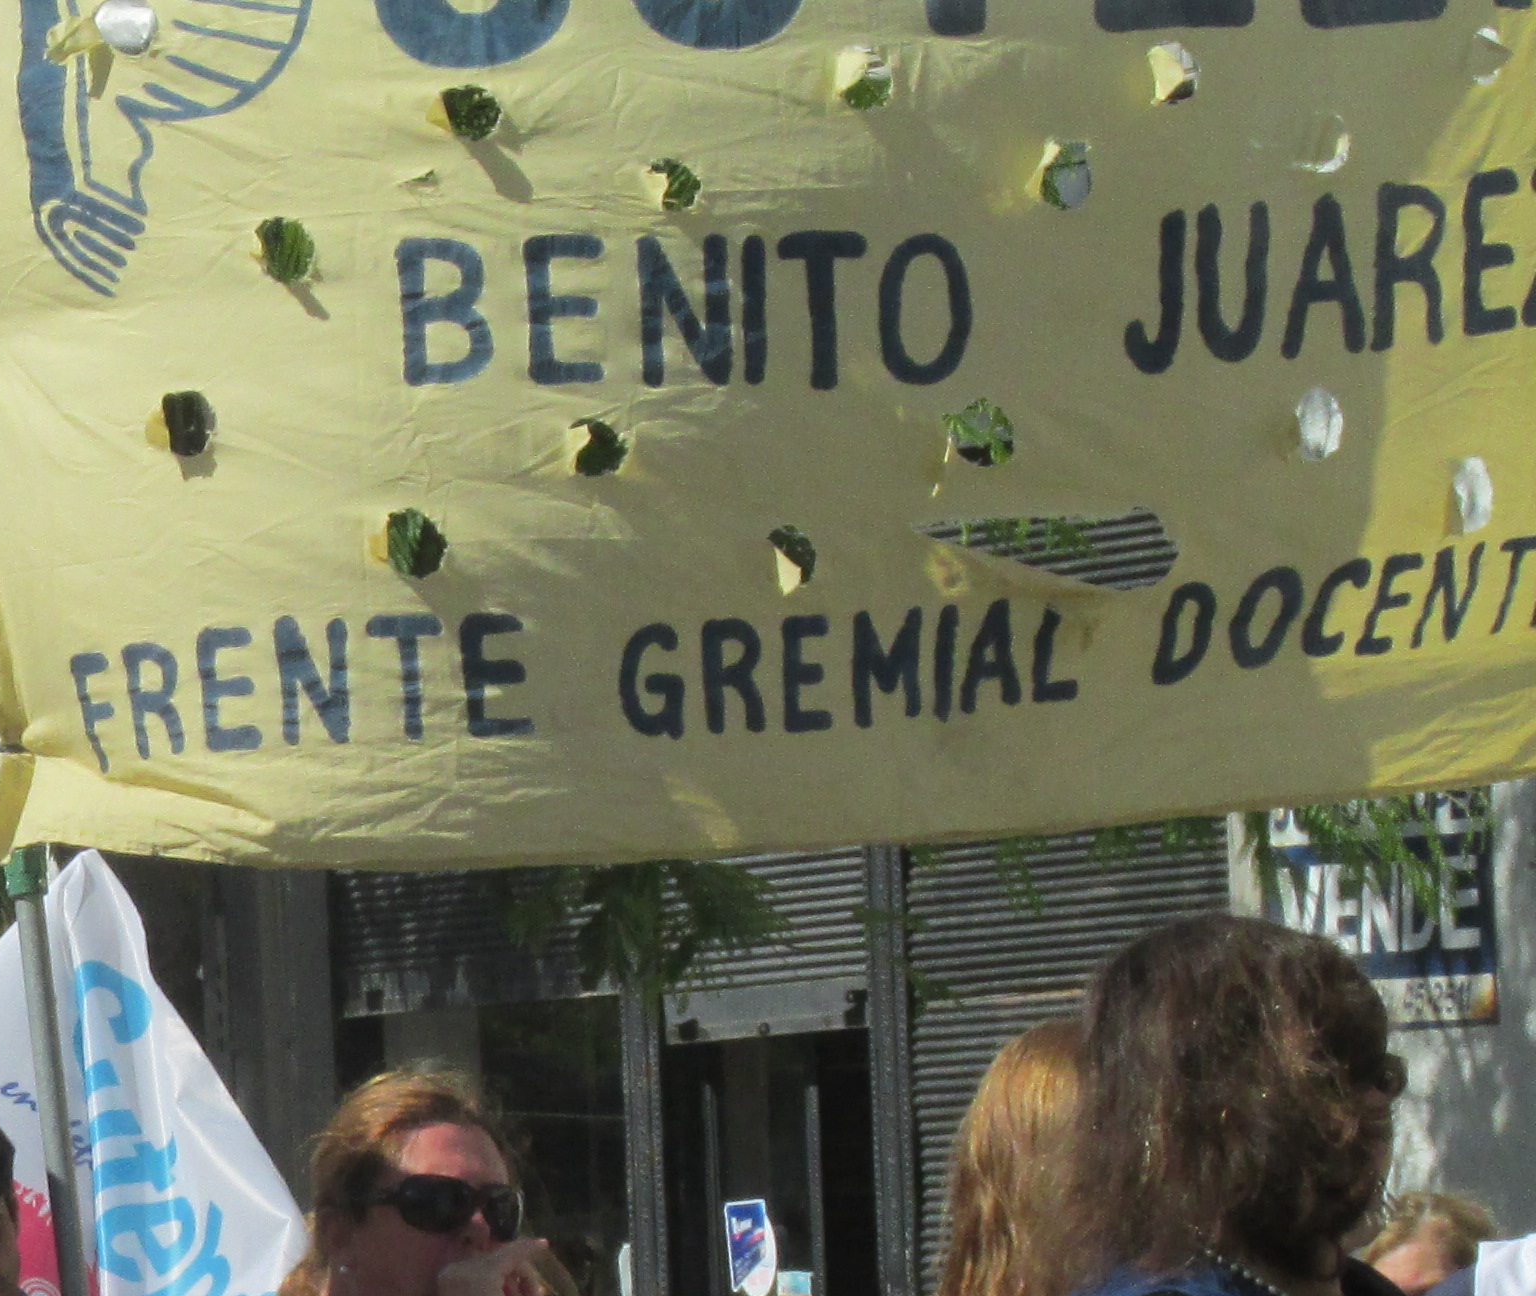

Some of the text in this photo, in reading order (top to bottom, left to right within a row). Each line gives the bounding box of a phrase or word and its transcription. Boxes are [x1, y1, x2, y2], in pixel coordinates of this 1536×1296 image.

[395, 167, 1536, 389] BENITO JUARE
[70, 536, 1536, 773] FRENTE GREMIAL DOCENT
[1276, 855, 1482, 955] VENDE
